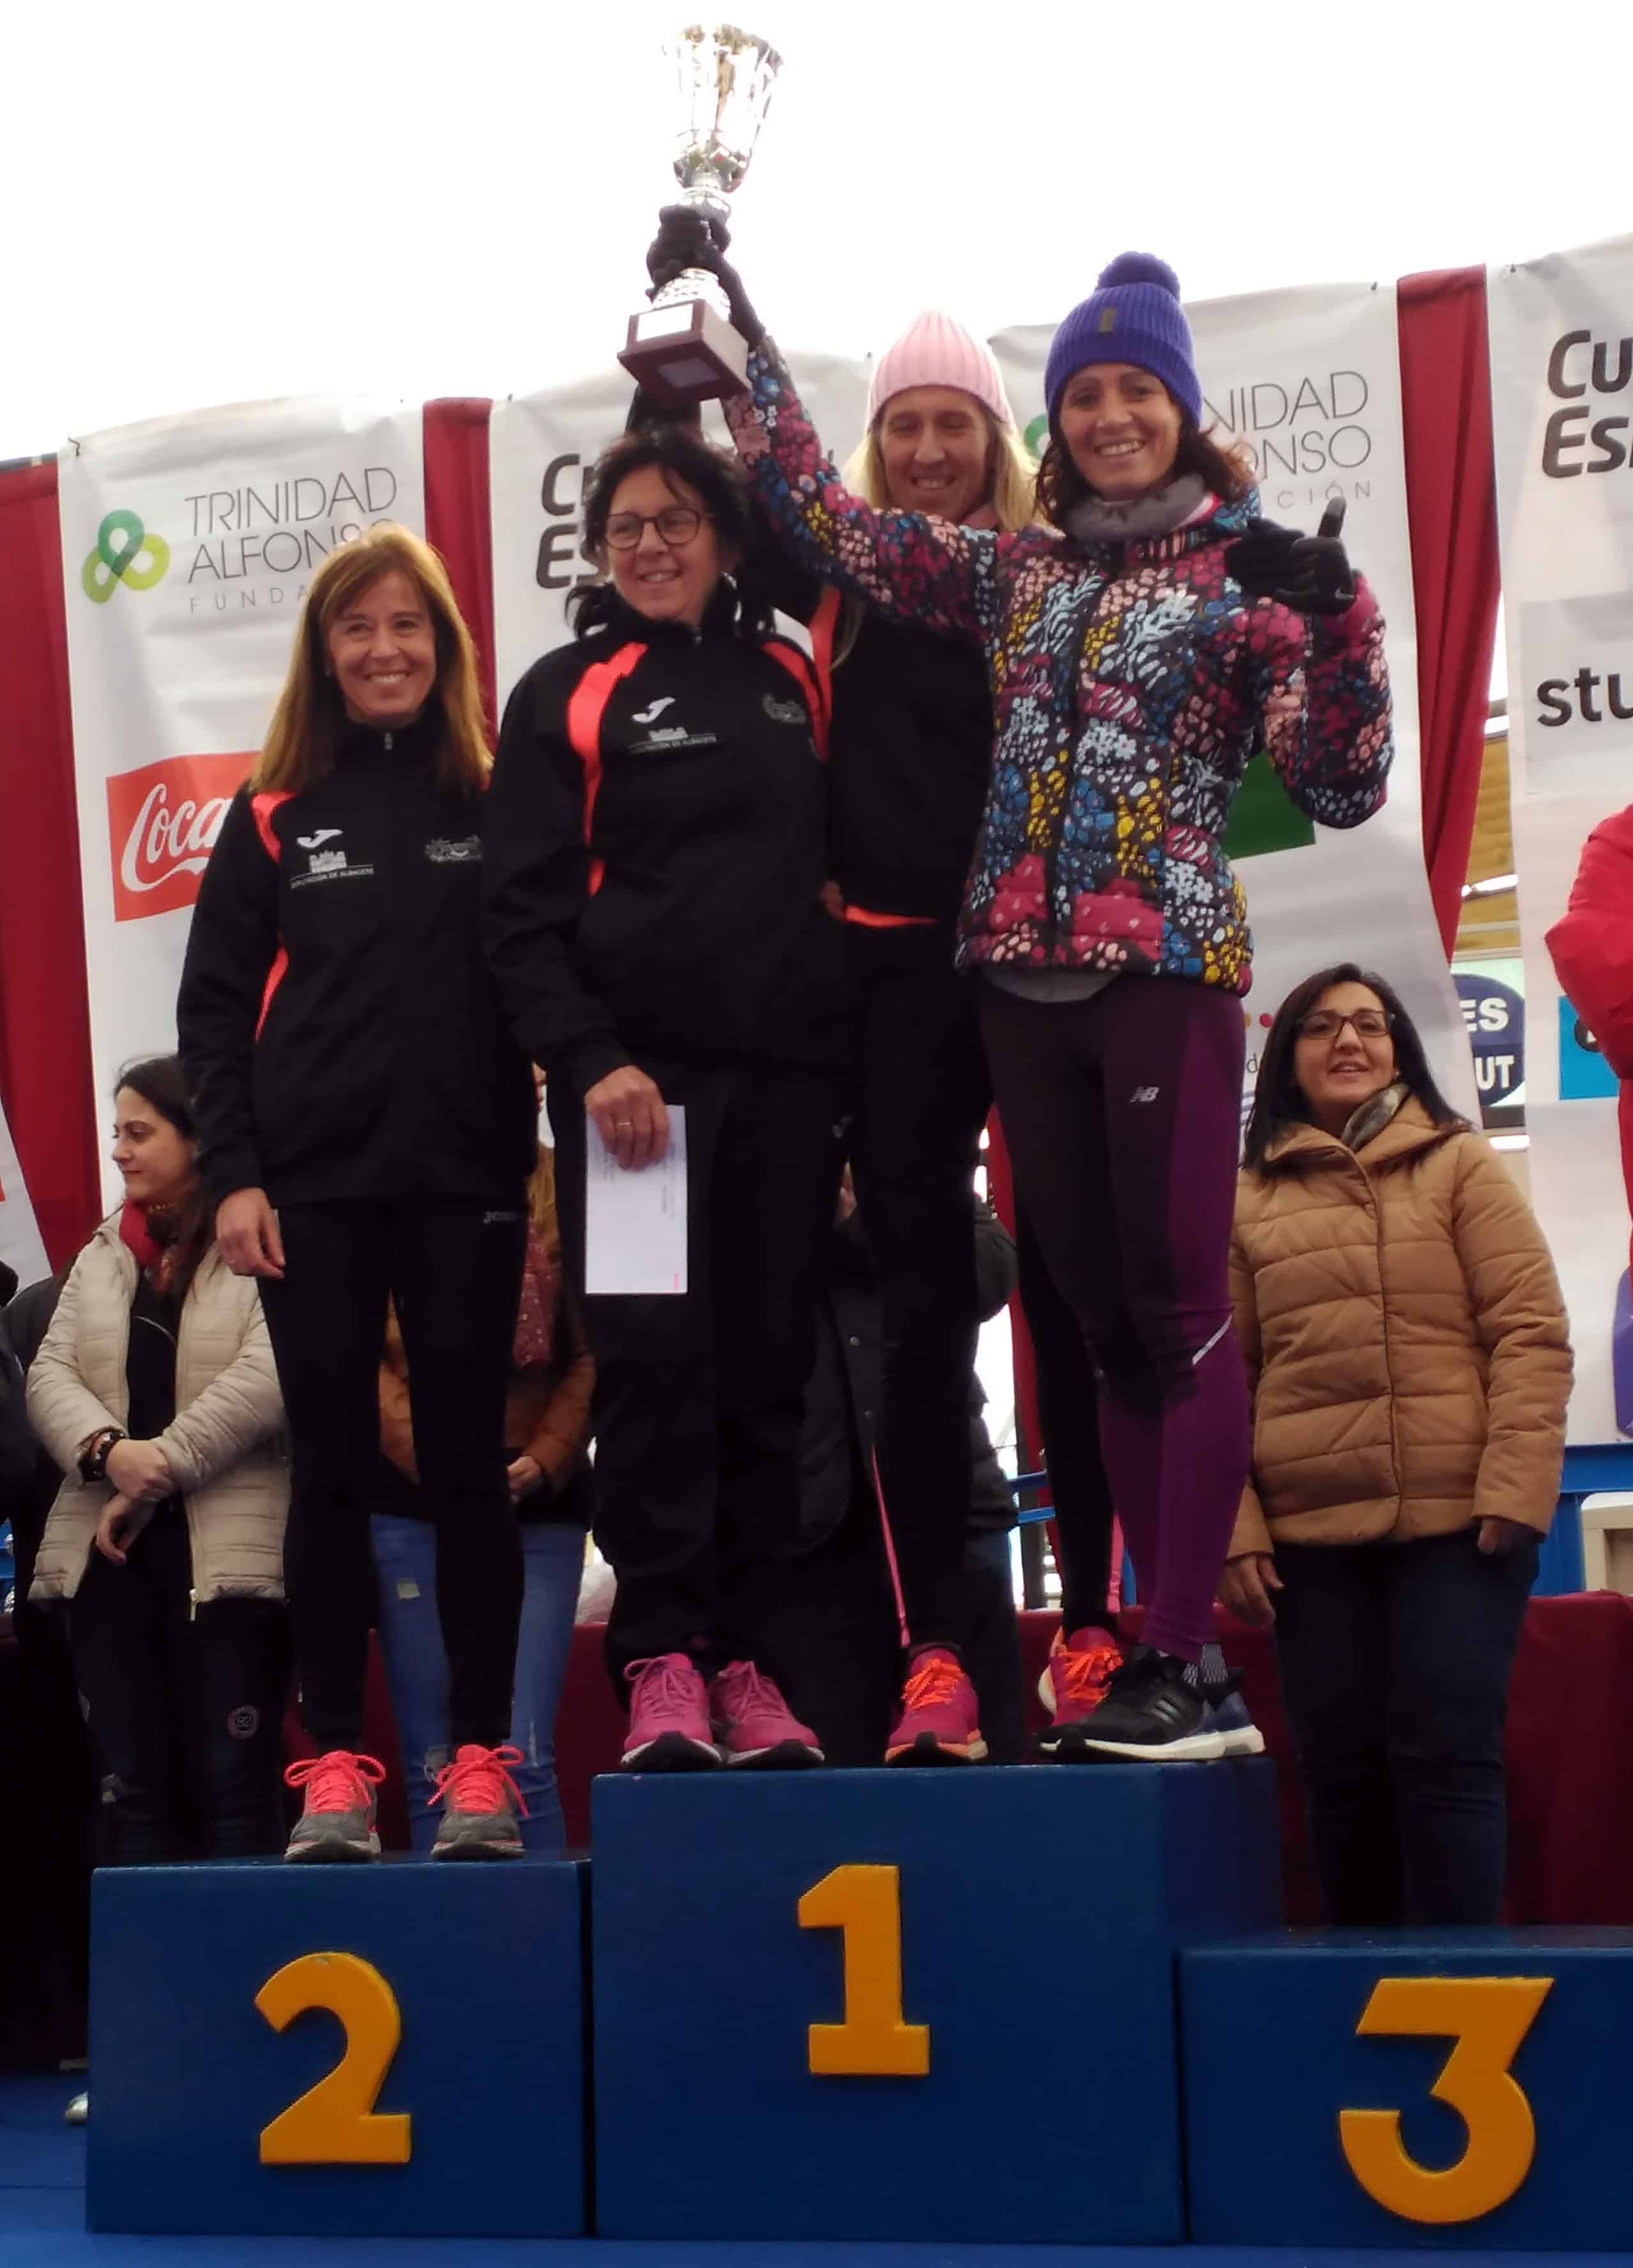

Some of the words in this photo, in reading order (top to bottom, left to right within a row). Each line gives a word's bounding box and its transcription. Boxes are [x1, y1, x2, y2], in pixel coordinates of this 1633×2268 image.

[1547, 329, 1633, 399] Cu
[1541, 405, 1633, 479] Es
[185, 467, 397, 537] TRINIDAD
[1537, 667, 1633, 727] stu
[121, 782, 234, 892] Coca
[797, 1864, 930, 2075] 1
[254, 1951, 411, 2164] 2
[1339, 1977, 1555, 2225] 3
